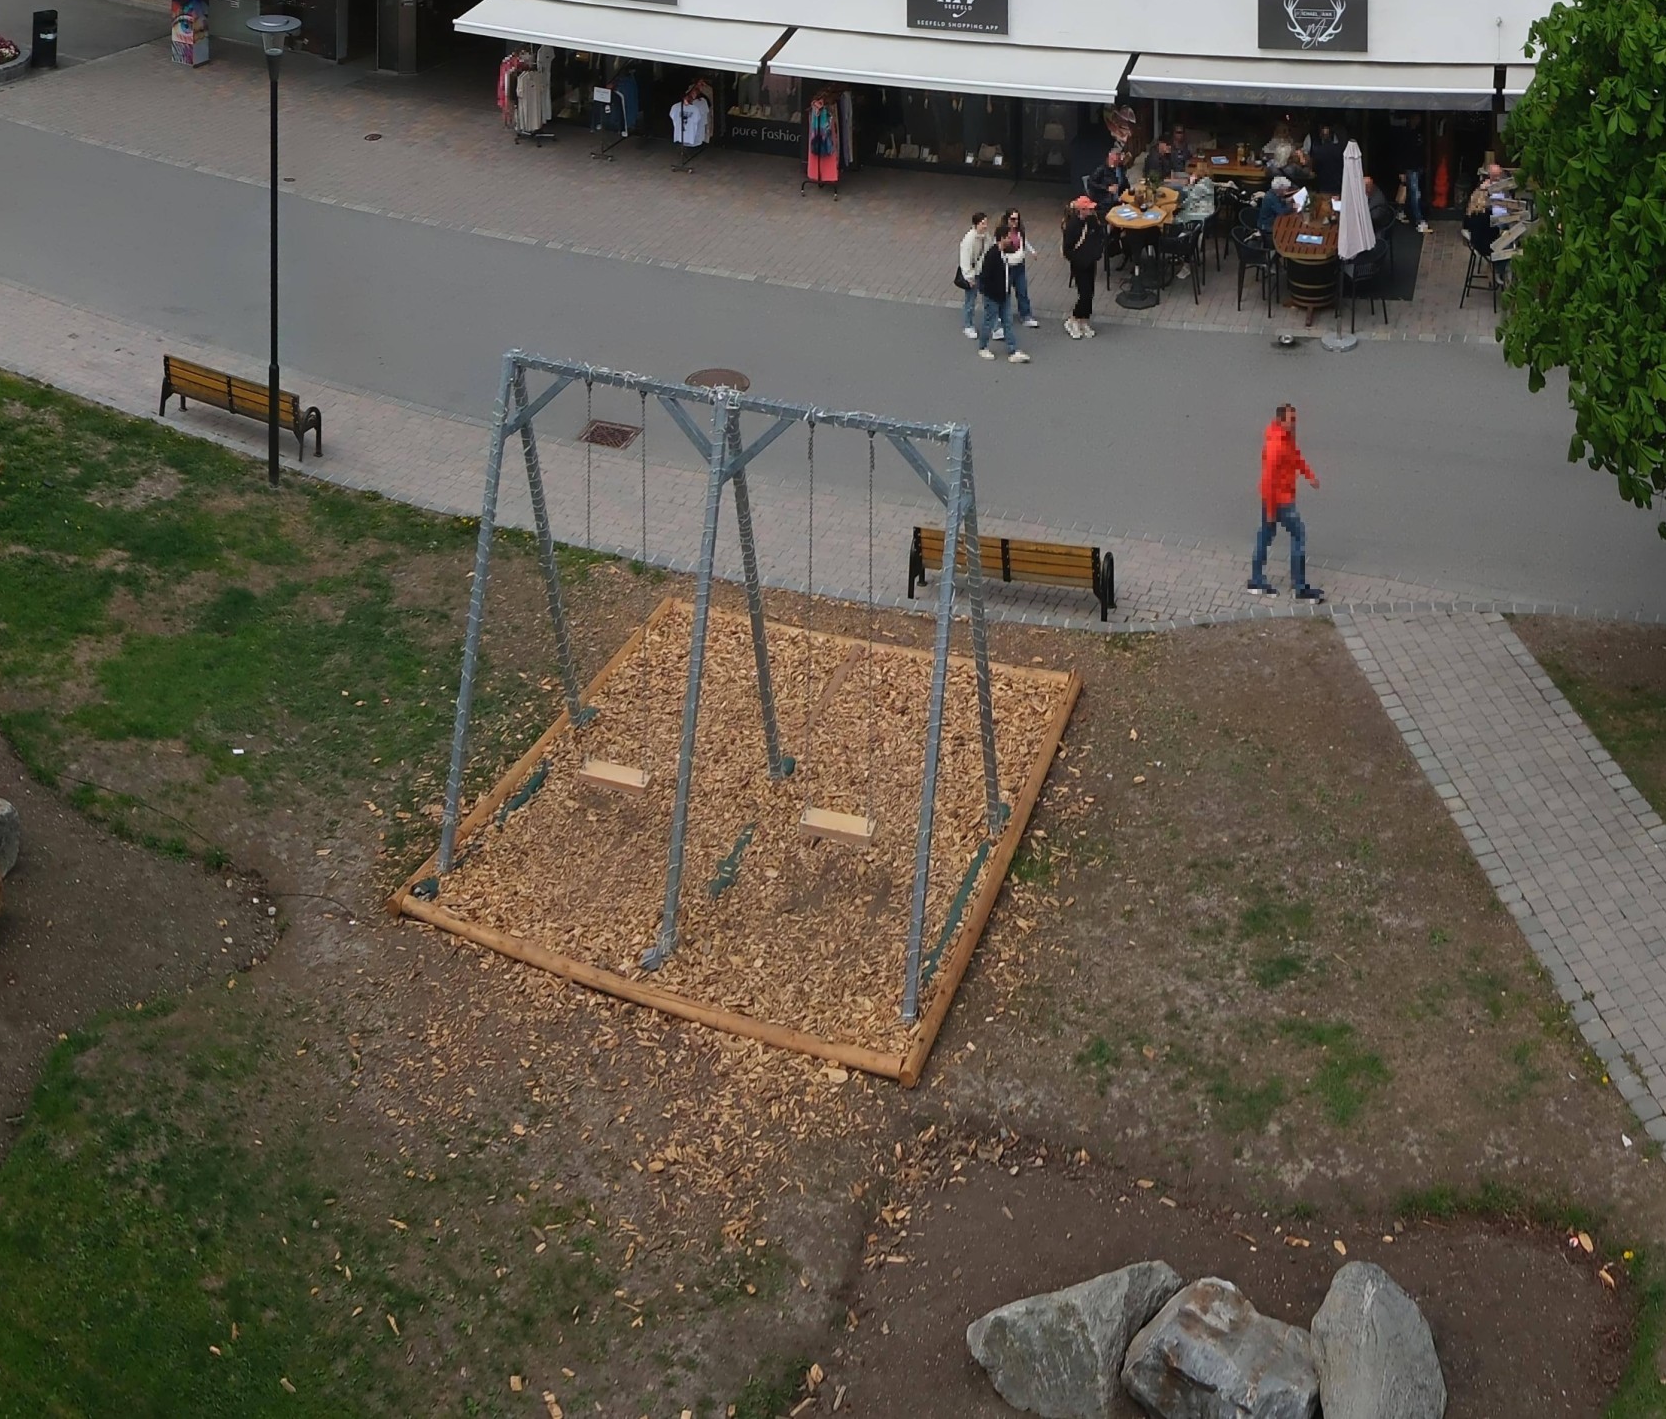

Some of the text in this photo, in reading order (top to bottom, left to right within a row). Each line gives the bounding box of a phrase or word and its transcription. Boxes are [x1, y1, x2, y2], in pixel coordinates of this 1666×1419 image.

[944, 3, 973, 11] SEEFELD
[948, 22, 983, 30] SHOPPING
[732, 126, 758, 137] pure
